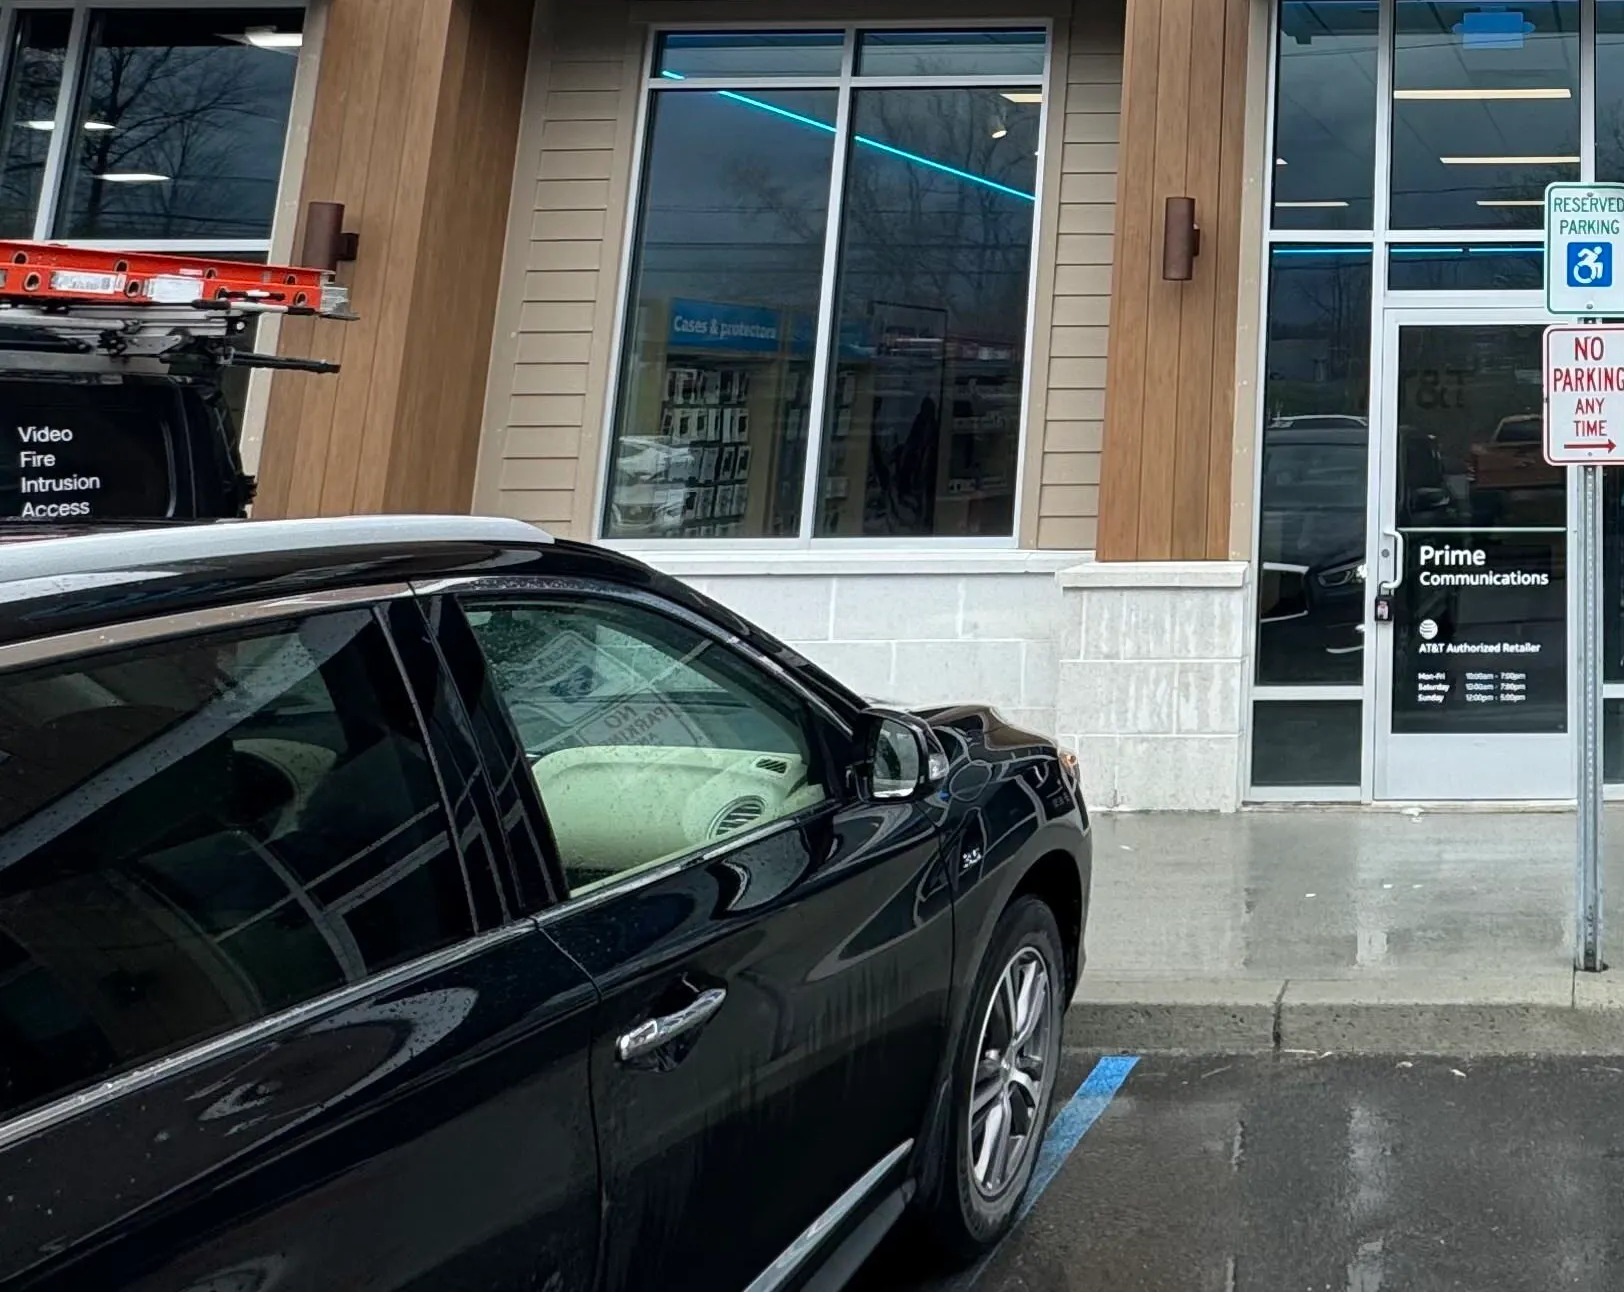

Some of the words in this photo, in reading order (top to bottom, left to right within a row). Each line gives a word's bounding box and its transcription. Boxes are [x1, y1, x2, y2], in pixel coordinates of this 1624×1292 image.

[1559, 219, 1620, 235] PARKING
[673, 315, 708, 333] Cases
[708, 318, 718, 336] &
[1574, 336, 1605, 361] NO
[1575, 397, 1606, 415] ANY
[17, 425, 73, 443] Video
[1573, 420, 1608, 437] TIME
[20, 450, 56, 468] Fire
[21, 473, 101, 494] Intrusion
[22, 501, 91, 518] Access
[1419, 544, 1487, 566] Prime
[1419, 570, 1549, 586] Communications
[1418, 642, 1445, 654] AT&T
[1446, 642, 1501, 654] Authorized
[1502, 642, 1542, 654] Retailer
